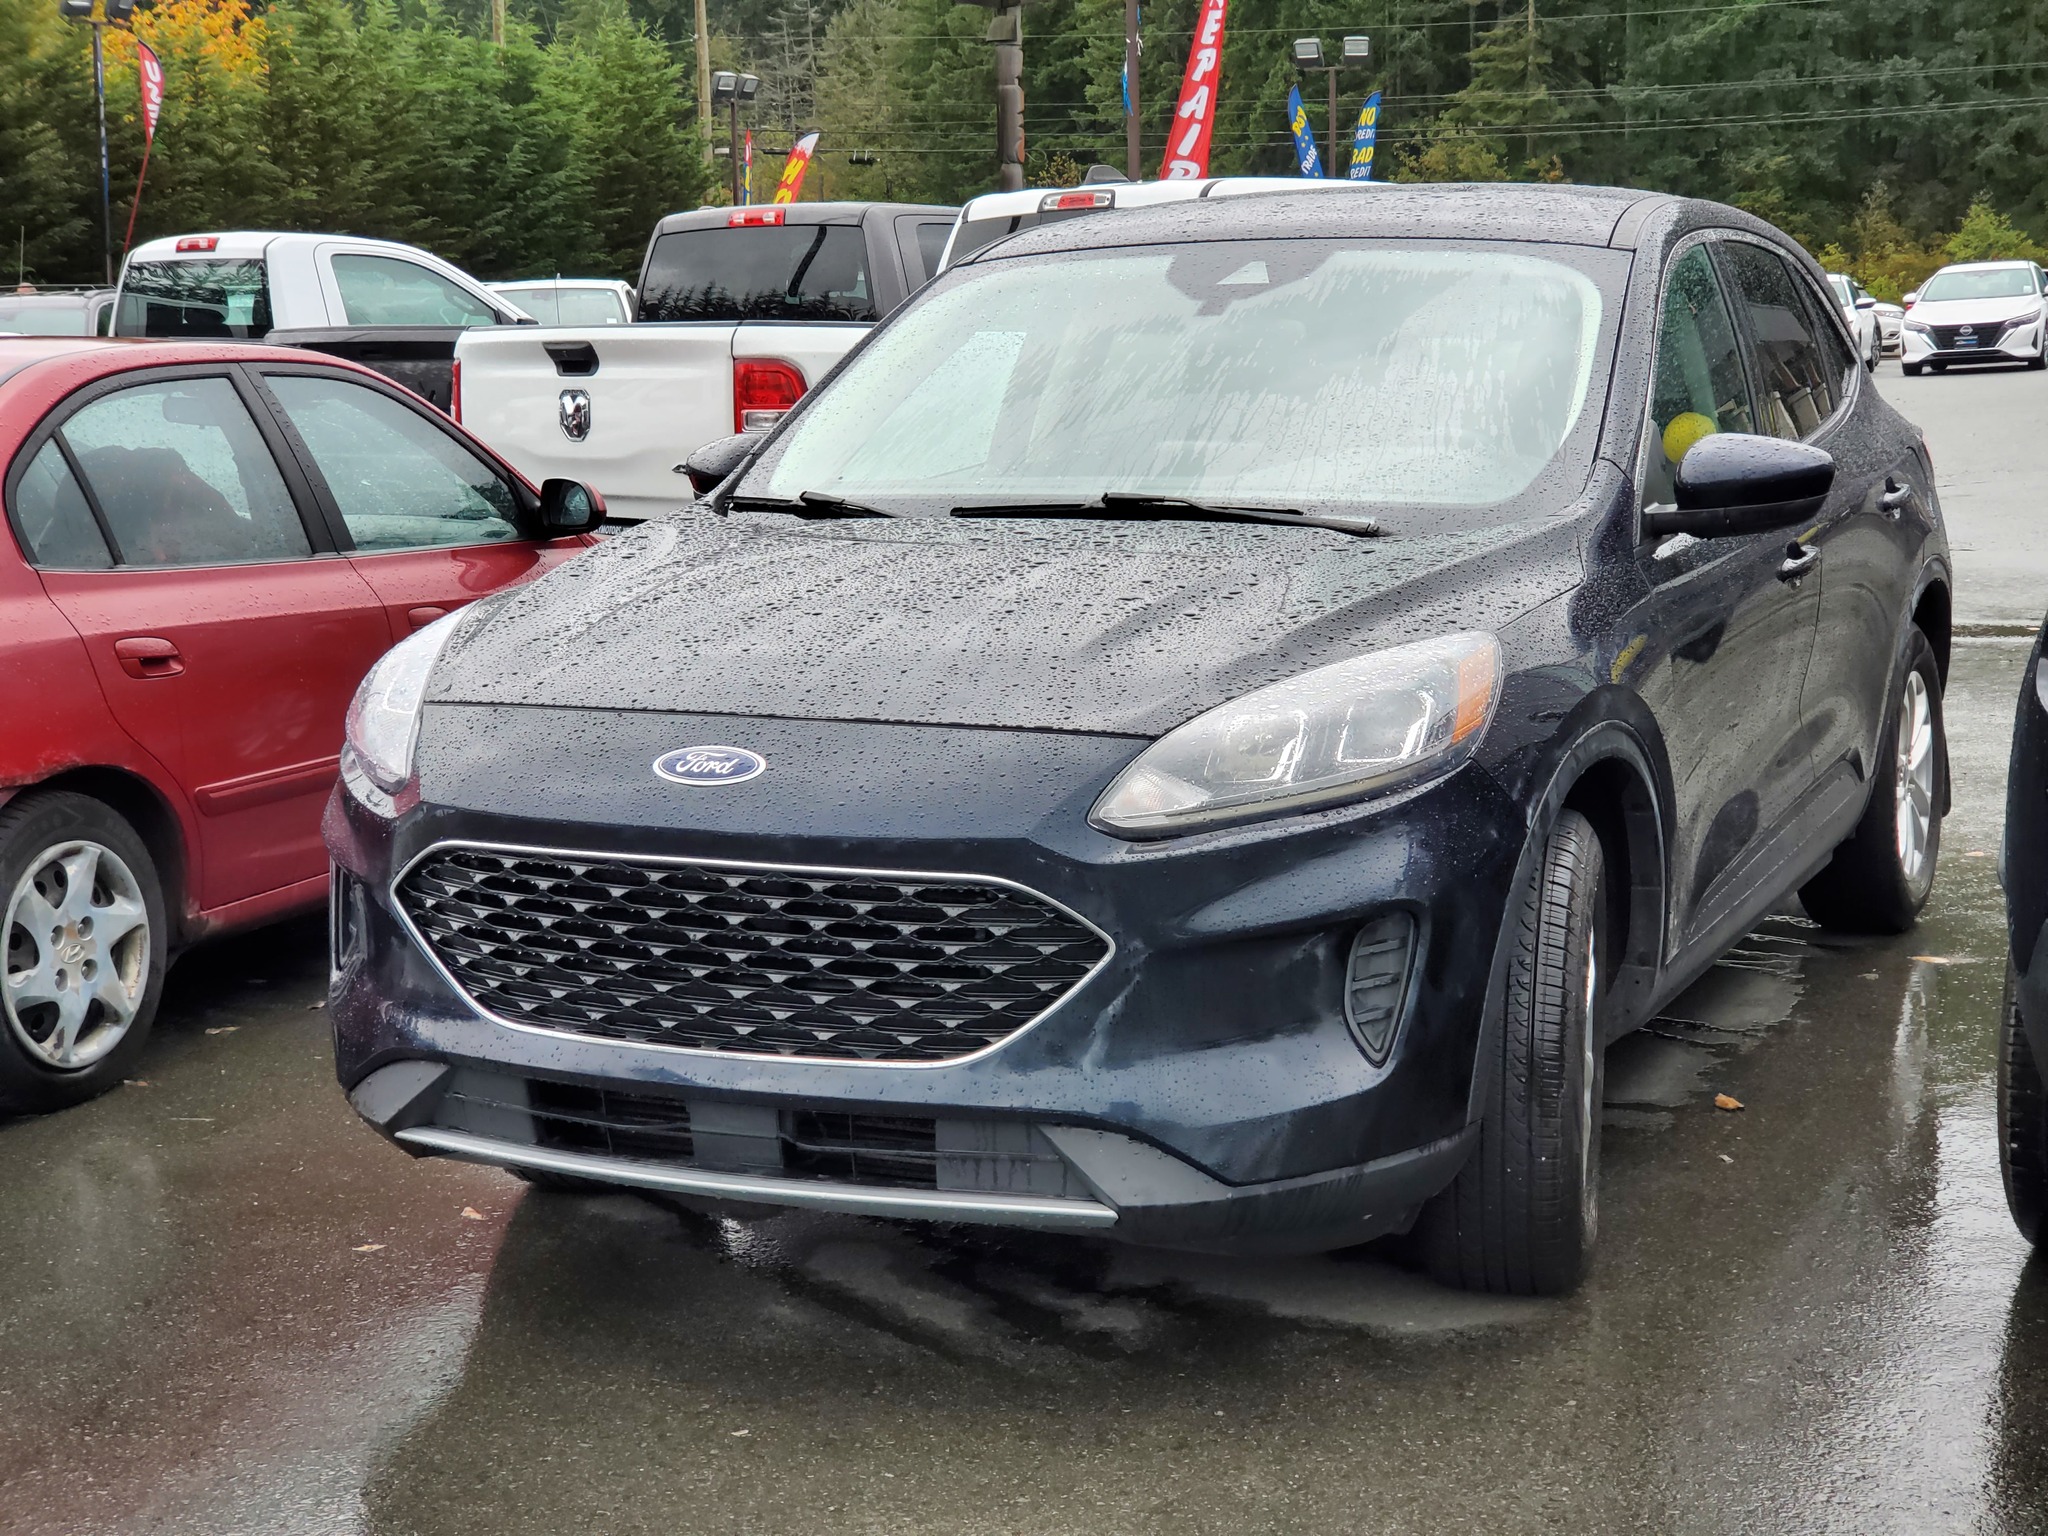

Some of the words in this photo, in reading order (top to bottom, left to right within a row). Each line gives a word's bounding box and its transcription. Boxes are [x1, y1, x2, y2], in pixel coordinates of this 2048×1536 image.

[1167, 0, 1224, 180] EPAIR
[1358, 106, 1376, 127] NO
[1354, 128, 1375, 141] REDIT
[1350, 165, 1371, 179] REDIT
[676, 751, 739, 774] Ford
